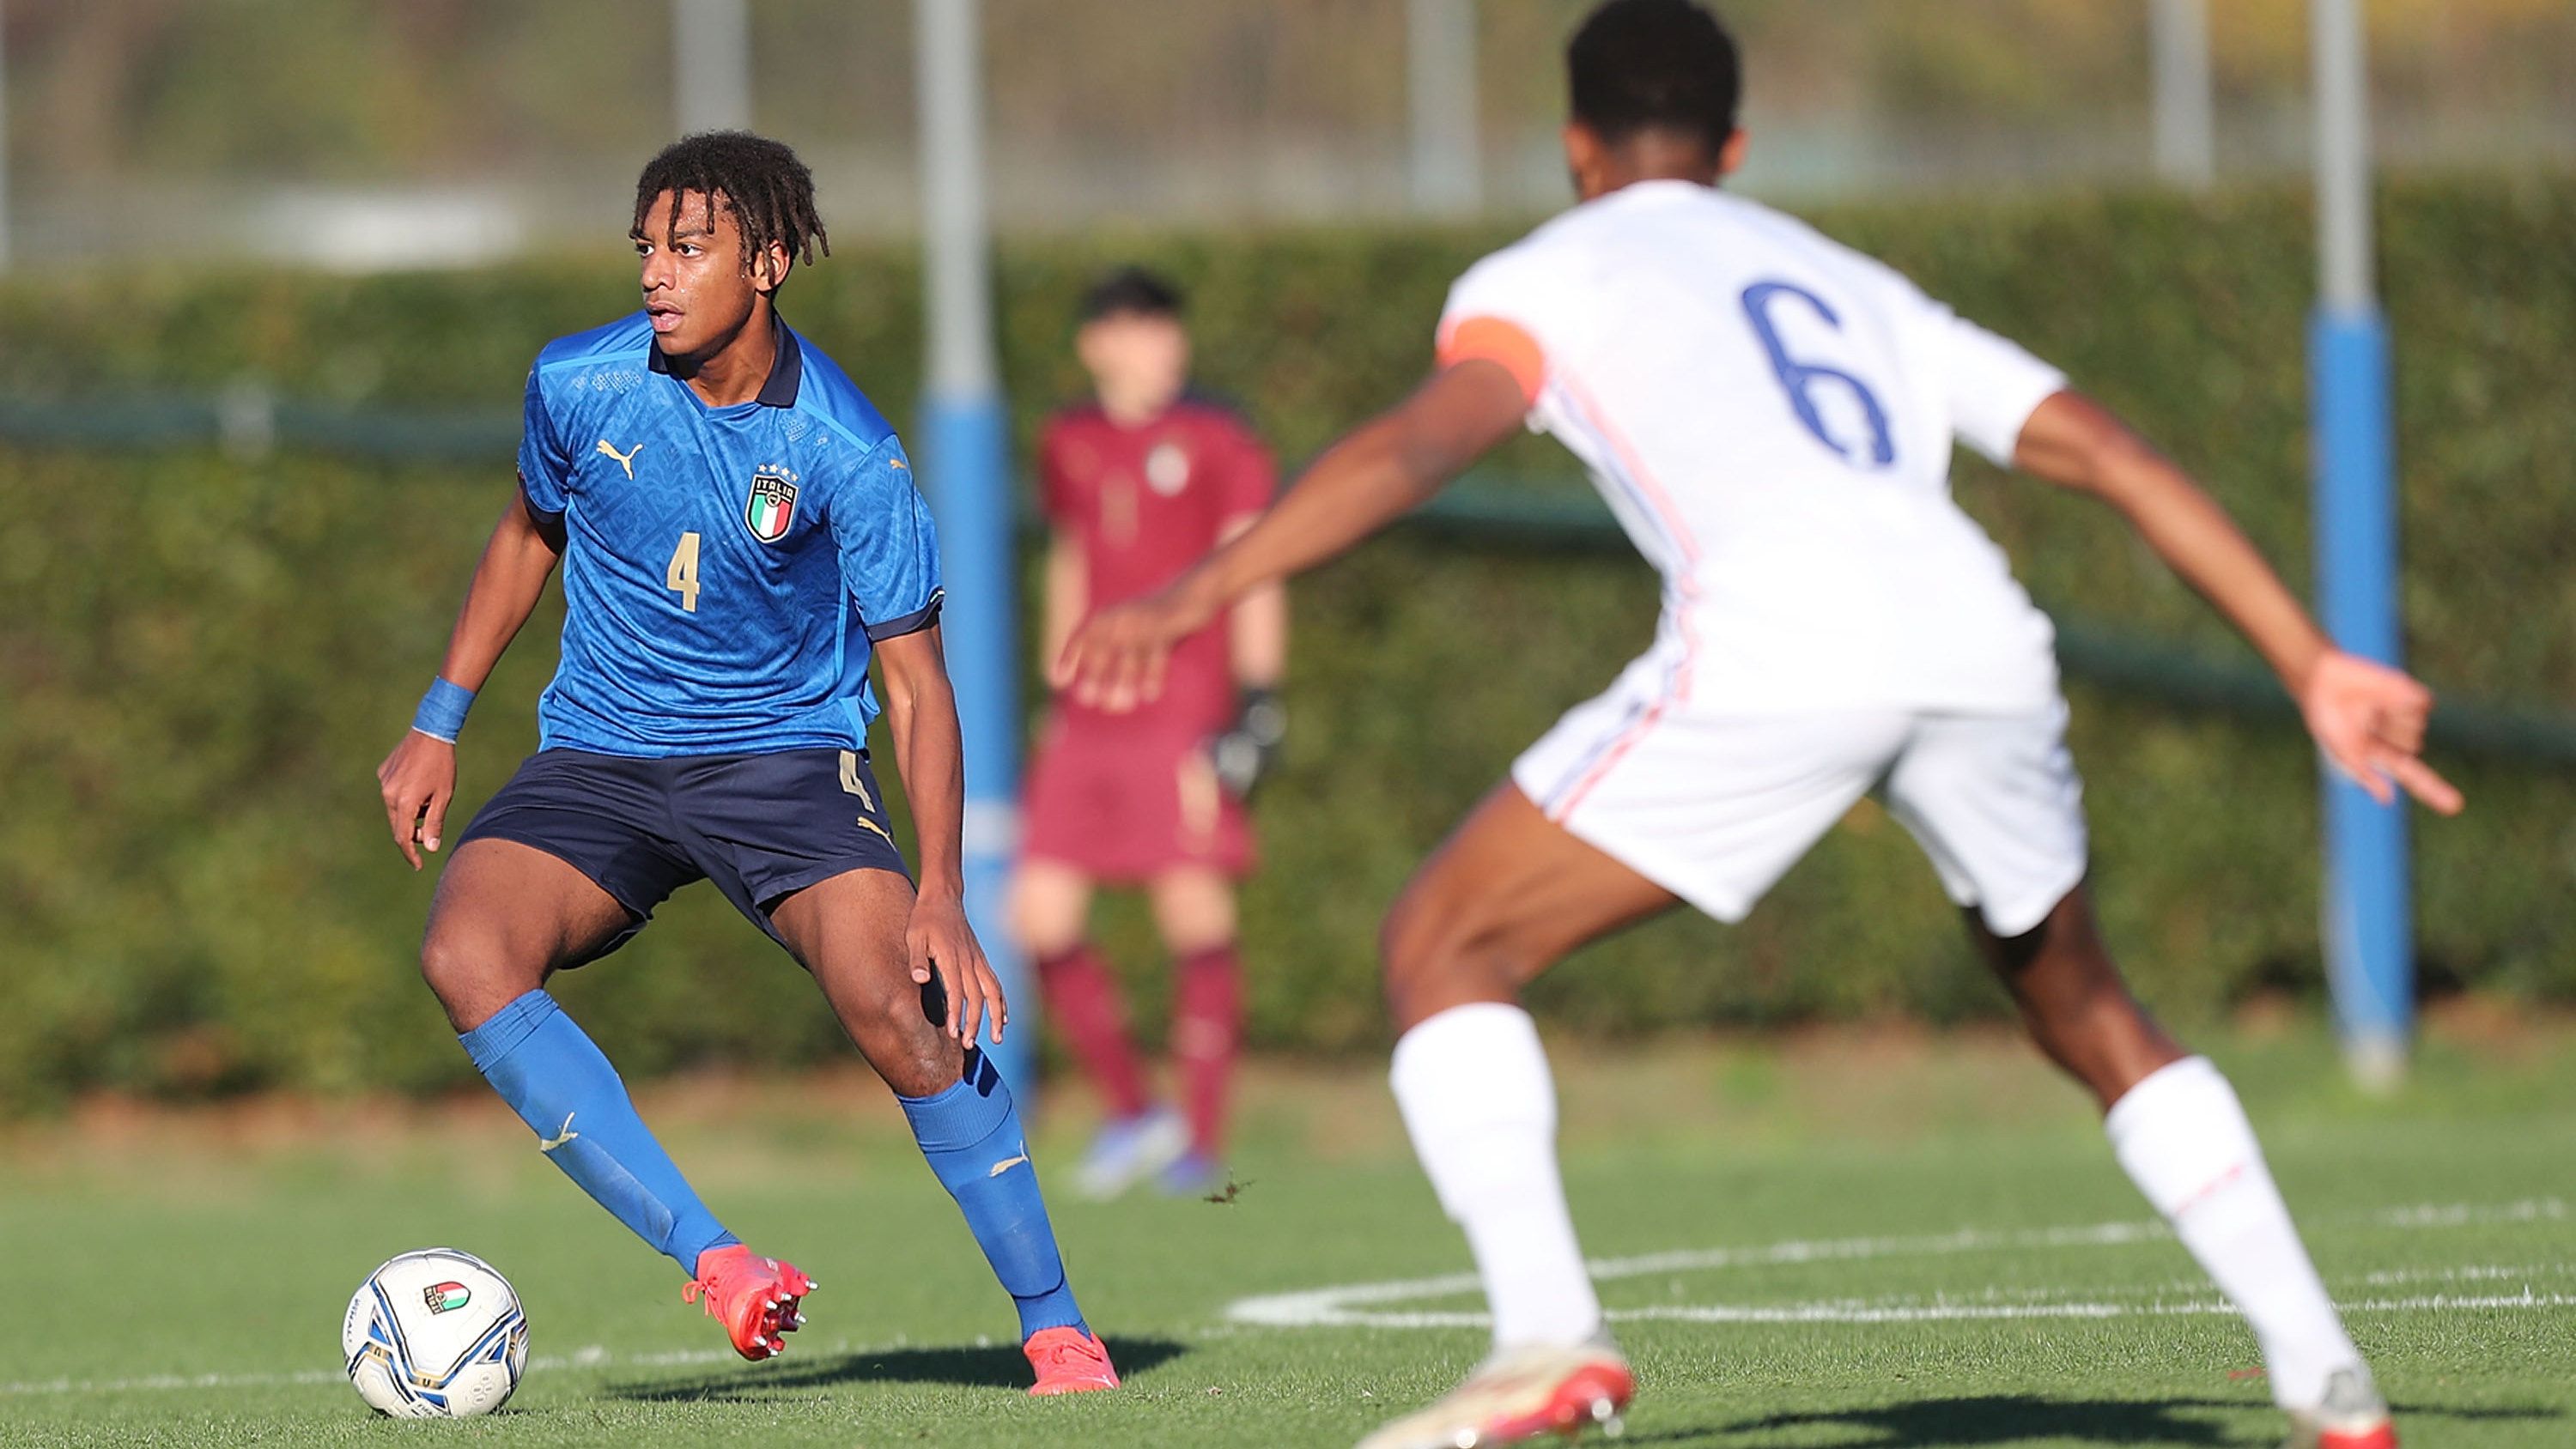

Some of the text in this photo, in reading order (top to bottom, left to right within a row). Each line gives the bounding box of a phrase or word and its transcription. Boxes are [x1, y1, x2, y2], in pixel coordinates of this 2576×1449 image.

[1742, 282, 1893, 464] 6
[756, 480, 793, 499] ITALIA
[667, 531, 701, 612] 4
[840, 749, 876, 813] 4
